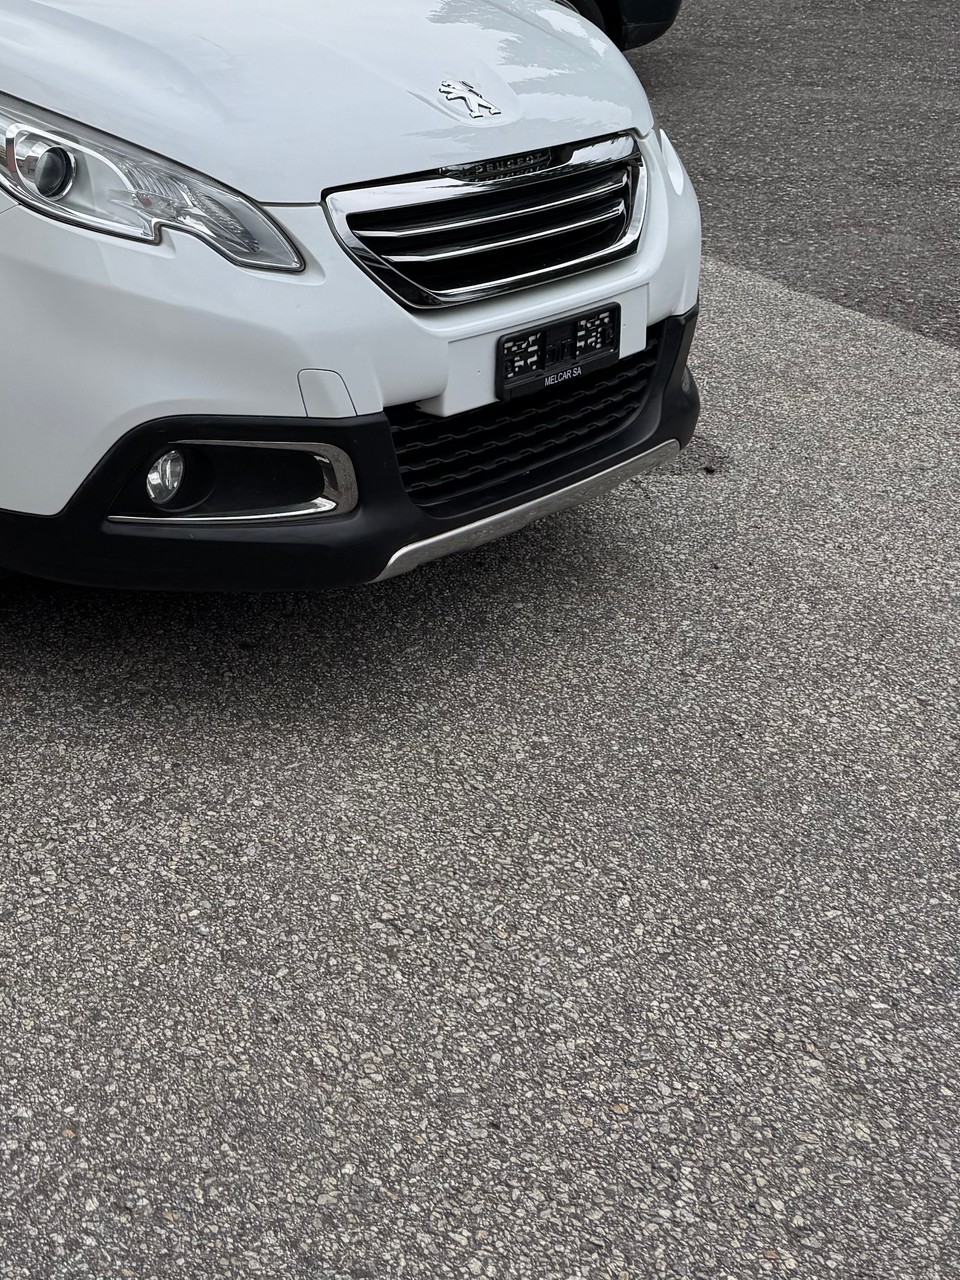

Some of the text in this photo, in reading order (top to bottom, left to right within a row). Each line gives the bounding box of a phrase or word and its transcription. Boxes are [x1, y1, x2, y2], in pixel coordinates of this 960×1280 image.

[475, 153, 542, 175] PEUGEOT
[544, 366, 582, 386] MELCAR SA
